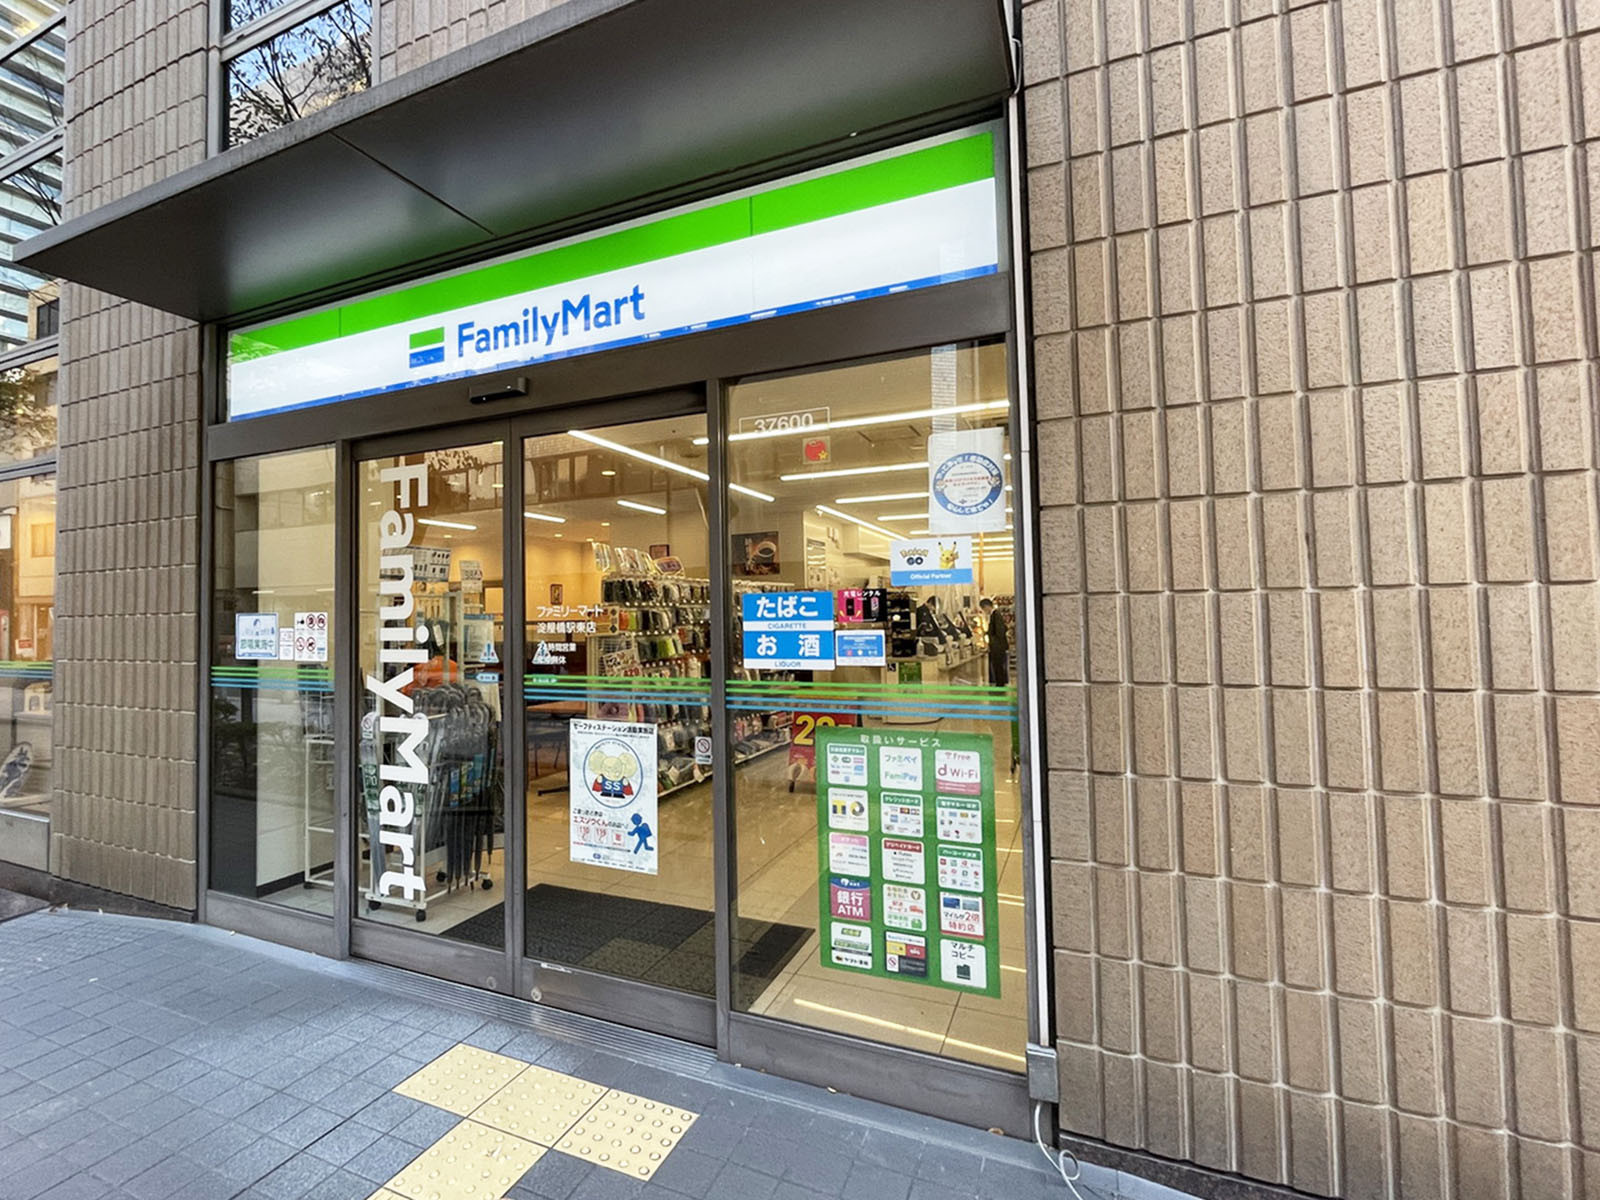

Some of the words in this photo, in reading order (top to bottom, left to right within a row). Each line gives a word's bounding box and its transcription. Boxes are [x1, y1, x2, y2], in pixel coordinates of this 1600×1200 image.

[458, 284, 645, 357] FamilyMart
[753, 412, 814, 434] 37600
[907, 557, 923, 565] GO
[536, 604, 604, 617] ファミリーマート
[756, 595, 819, 618] たばこ
[768, 622, 807, 630] CIGARETTE
[366, 463, 429, 900] FamilyMart
[860, 734, 941, 748] 取扱いサービス
[884, 754, 918, 764] ファミペイ
[884, 771, 918, 782] FamiPay
[938, 764, 947, 776] d
[950, 768, 979, 779] Wi-Fi
[604, 781, 622, 791] SS
[837, 890, 863, 906] 銀行
[837, 904, 864, 917] ATM
[951, 941, 975, 952] マルチ
[952, 950, 975, 960] コピー
